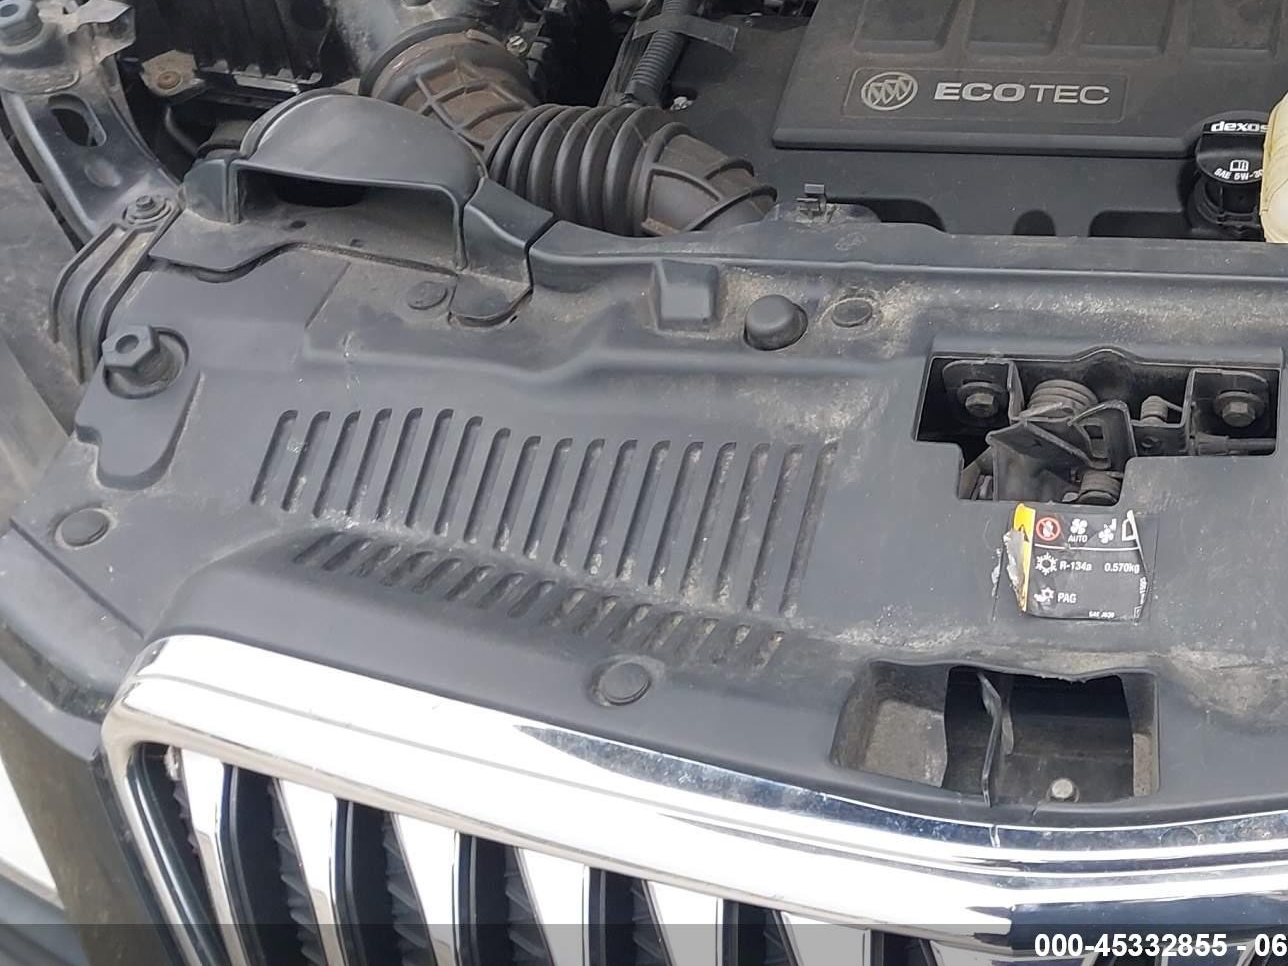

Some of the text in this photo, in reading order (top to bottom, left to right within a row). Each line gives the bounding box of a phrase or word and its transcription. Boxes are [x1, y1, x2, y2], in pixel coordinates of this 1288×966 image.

[933, 82, 1111, 105] ECOTEC
[1211, 121, 1270, 132] dexos
[1214, 168, 1232, 180] SAE
[1068, 535, 1088, 543] AUTO
[1059, 561, 1141, 574] R-134a 0.570kg
[1057, 592, 1077, 604] PAG
